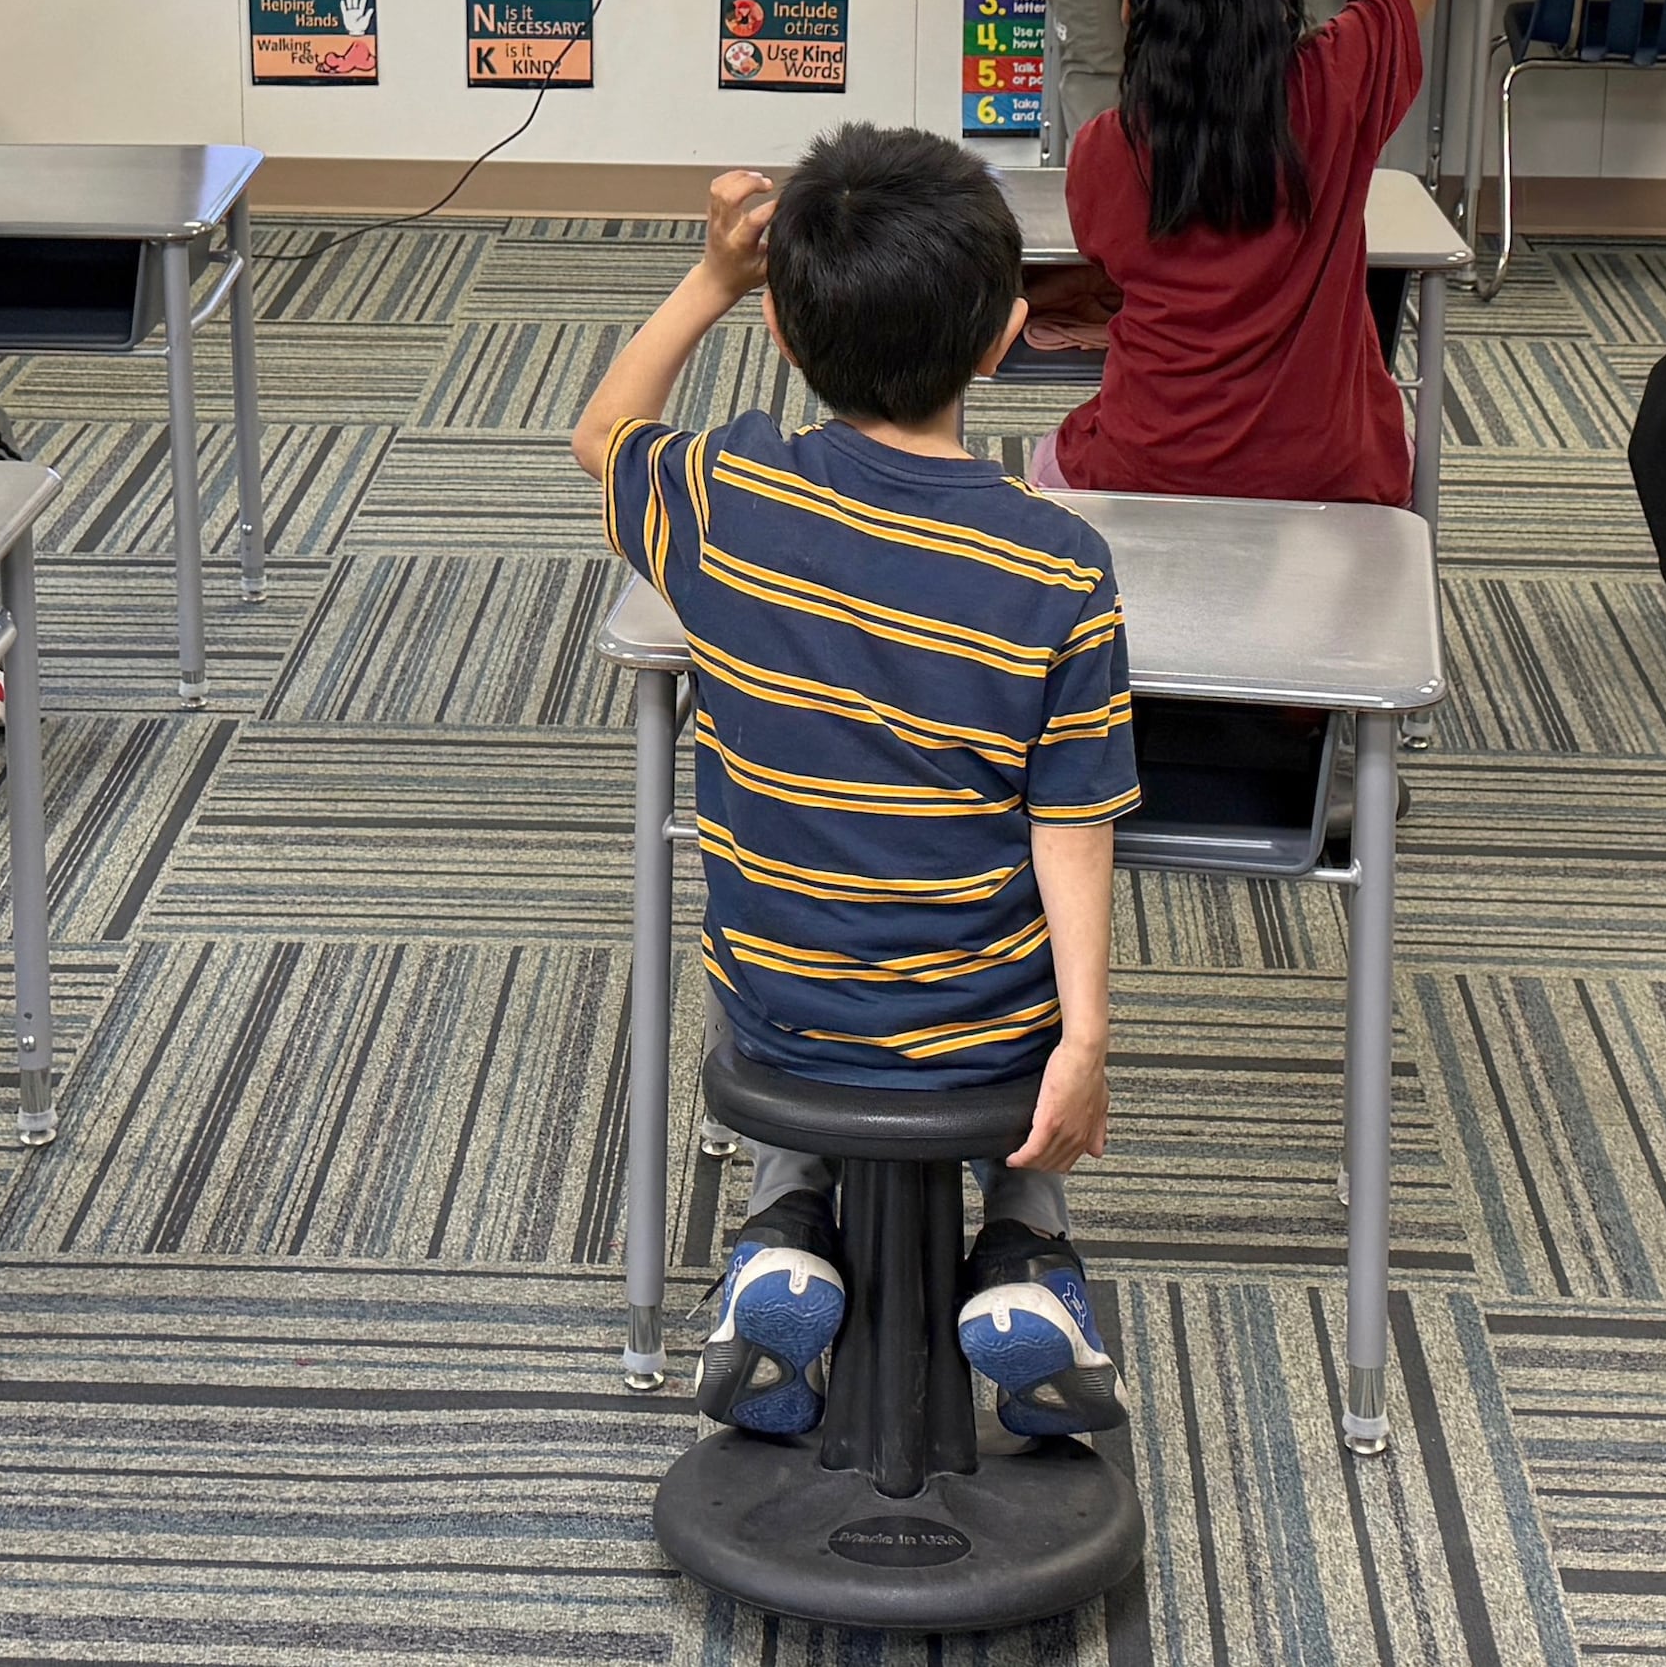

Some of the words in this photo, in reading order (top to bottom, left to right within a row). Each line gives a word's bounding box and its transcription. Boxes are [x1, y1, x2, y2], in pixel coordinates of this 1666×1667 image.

[473, 4, 495, 33] N
[506, 5, 517, 20] is
[522, 5, 533, 20] it
[773, 1, 837, 19] Include
[295, 13, 339, 28] Hands
[784, 19, 839, 36] others
[257, 39, 311, 55] Walking
[768, 45, 799, 62] Use
[803, 46, 844, 64] Kind
[291, 51, 319, 64] Feet
[476, 47, 497, 75] K
[506, 43, 517, 57] is
[522, 43, 533, 57] it
[784, 61, 841, 80] Words
